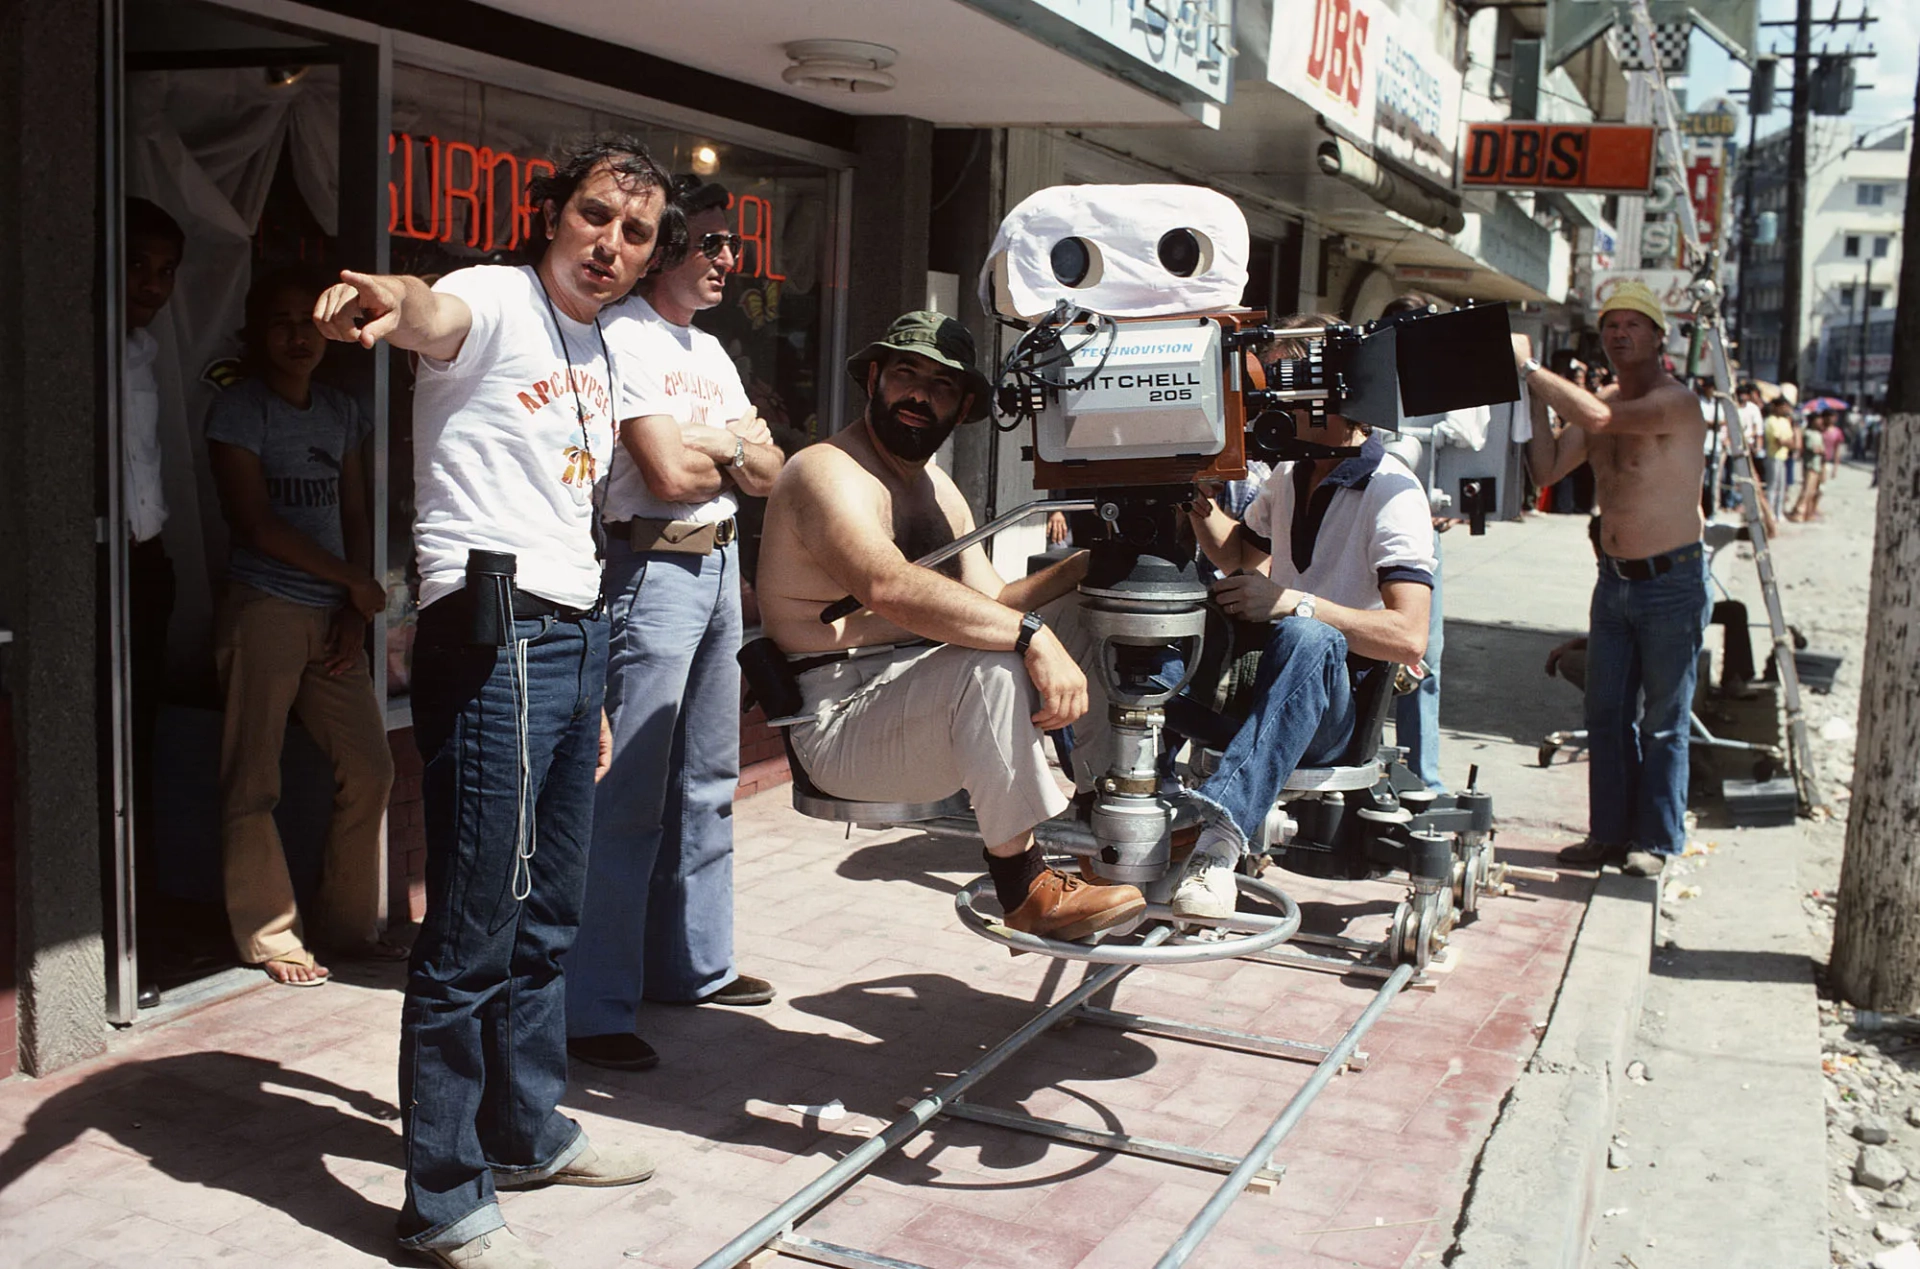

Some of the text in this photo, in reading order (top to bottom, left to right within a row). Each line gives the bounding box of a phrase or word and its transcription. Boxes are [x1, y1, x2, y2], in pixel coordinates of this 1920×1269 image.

[1306, 0, 1369, 110] DBS
[1681, 115, 1734, 135] CLUB
[1466, 129, 1583, 180] DBS
[1080, 343, 1193, 358] TECHNOVISION
[1067, 373, 1200, 391] MITCHELL
[1149, 389, 1192, 402] 205
